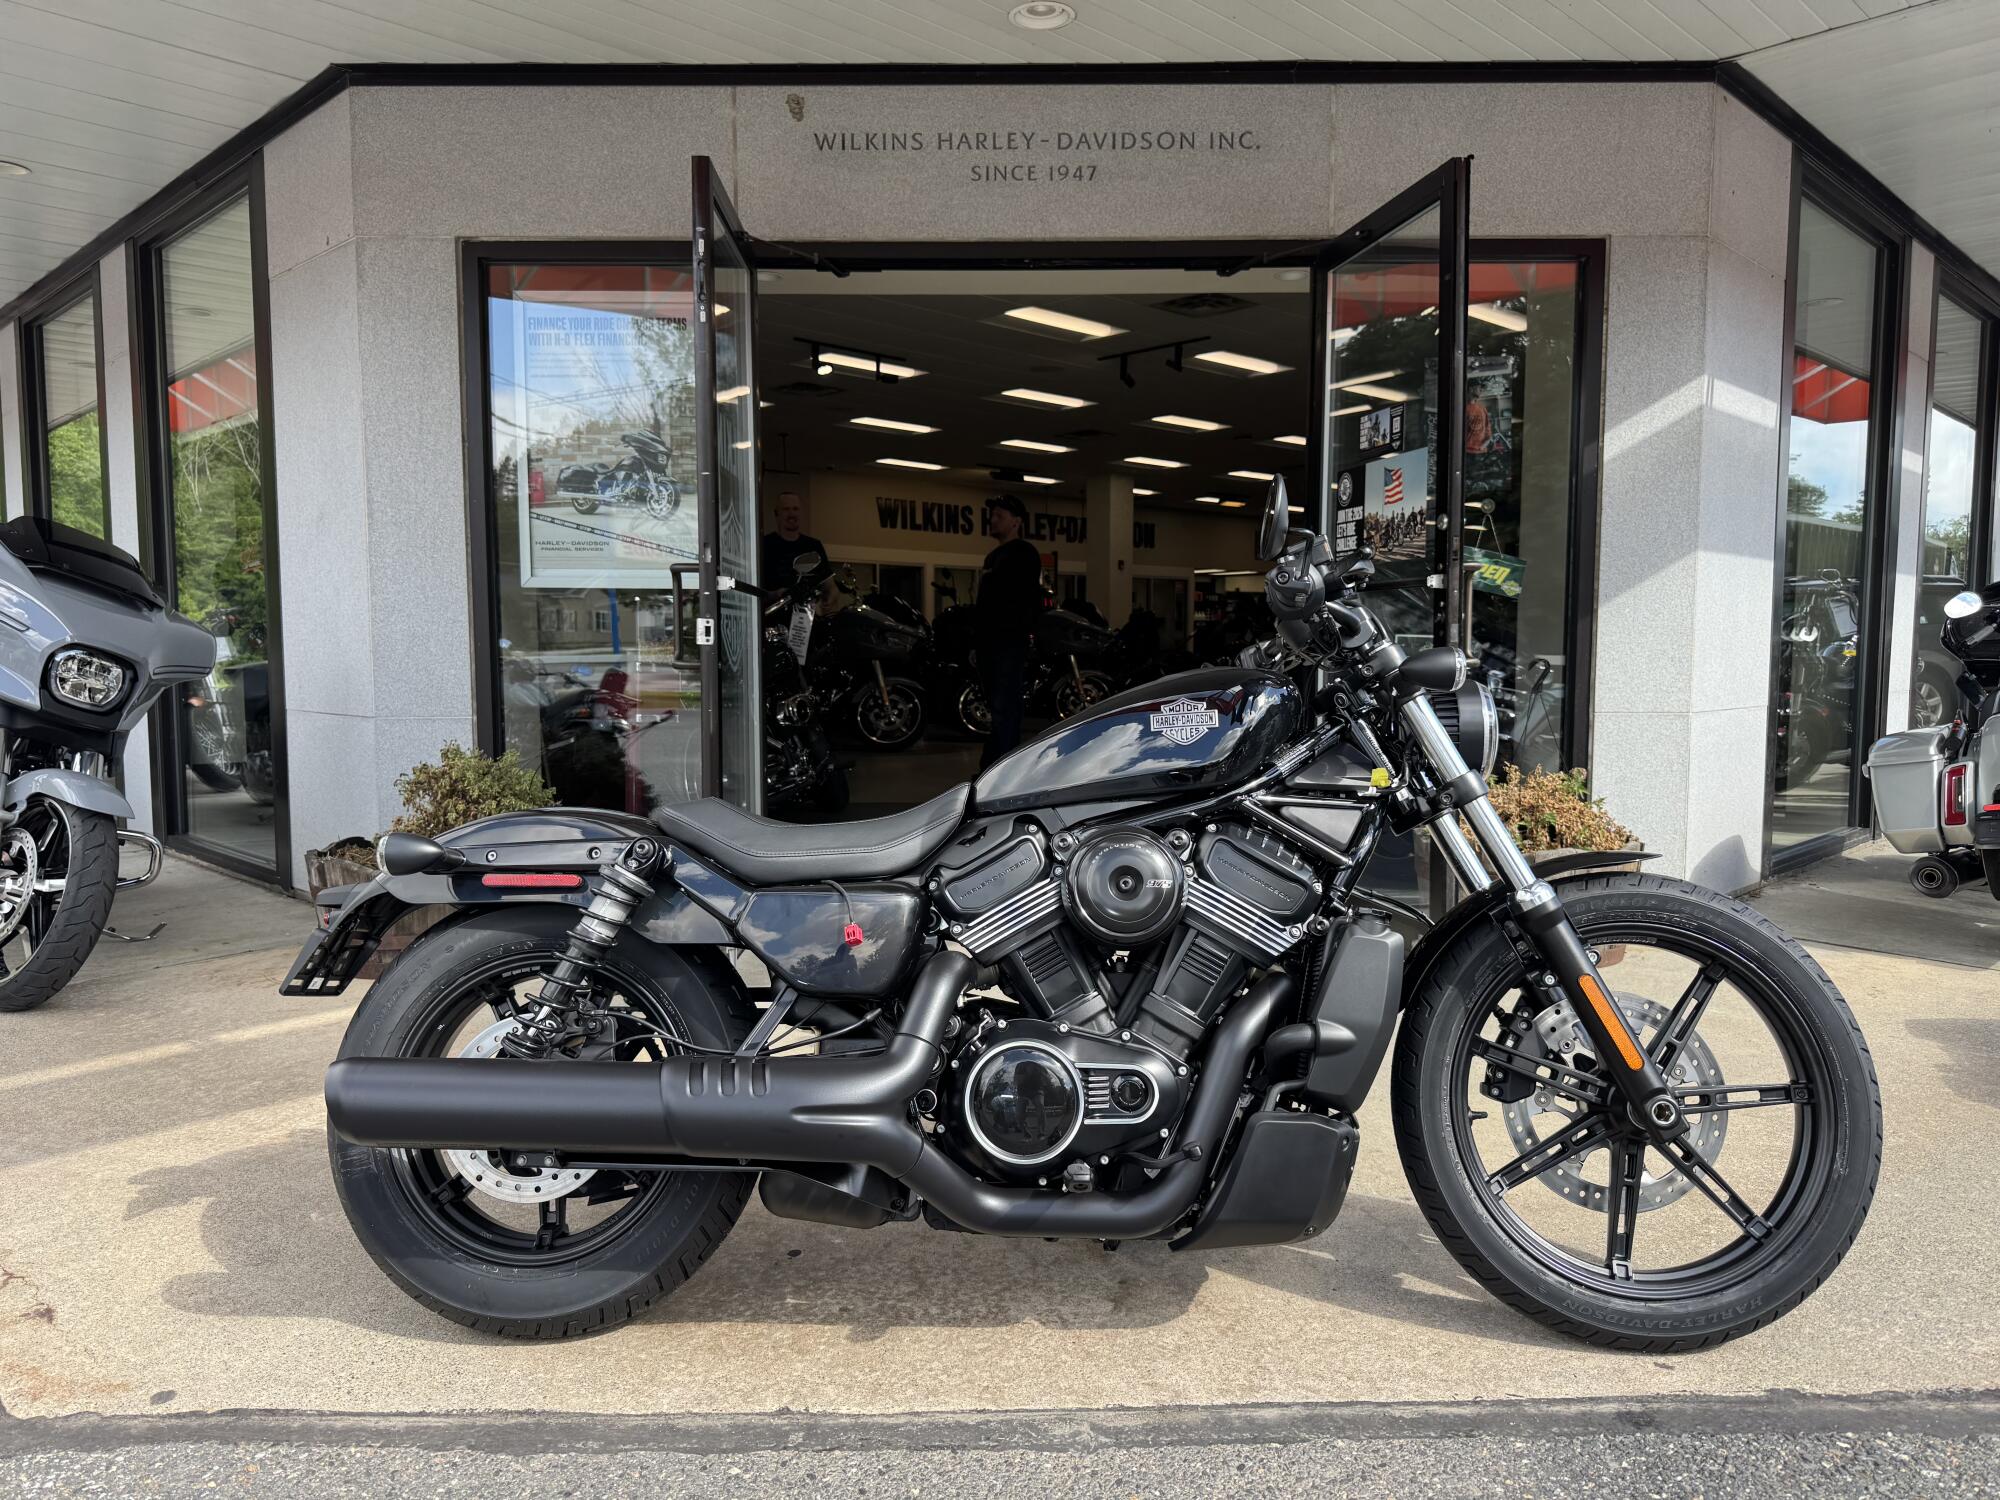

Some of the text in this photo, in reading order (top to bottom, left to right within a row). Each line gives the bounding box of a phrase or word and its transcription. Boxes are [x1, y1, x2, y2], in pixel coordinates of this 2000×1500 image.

[813, 131, 1261, 151] WILKINS HARLEY-DAVIDSON INC.
[970, 164, 1097, 182] SINCE 1947
[528, 316, 567, 331] FINANCE
[568, 316, 593, 331] YOUR
[594, 316, 616, 331] RIDE
[528, 332, 551, 347] WITH
[575, 332, 595, 346] FLEX
[875, 497, 974, 535] WILKINS
[1168, 702, 1199, 713] MOTOR
[1155, 713, 1214, 727] HARLEY-DAVIDSON
[1169, 727, 1200, 741] CYCLES
[1145, 879, 1173, 889] 975
